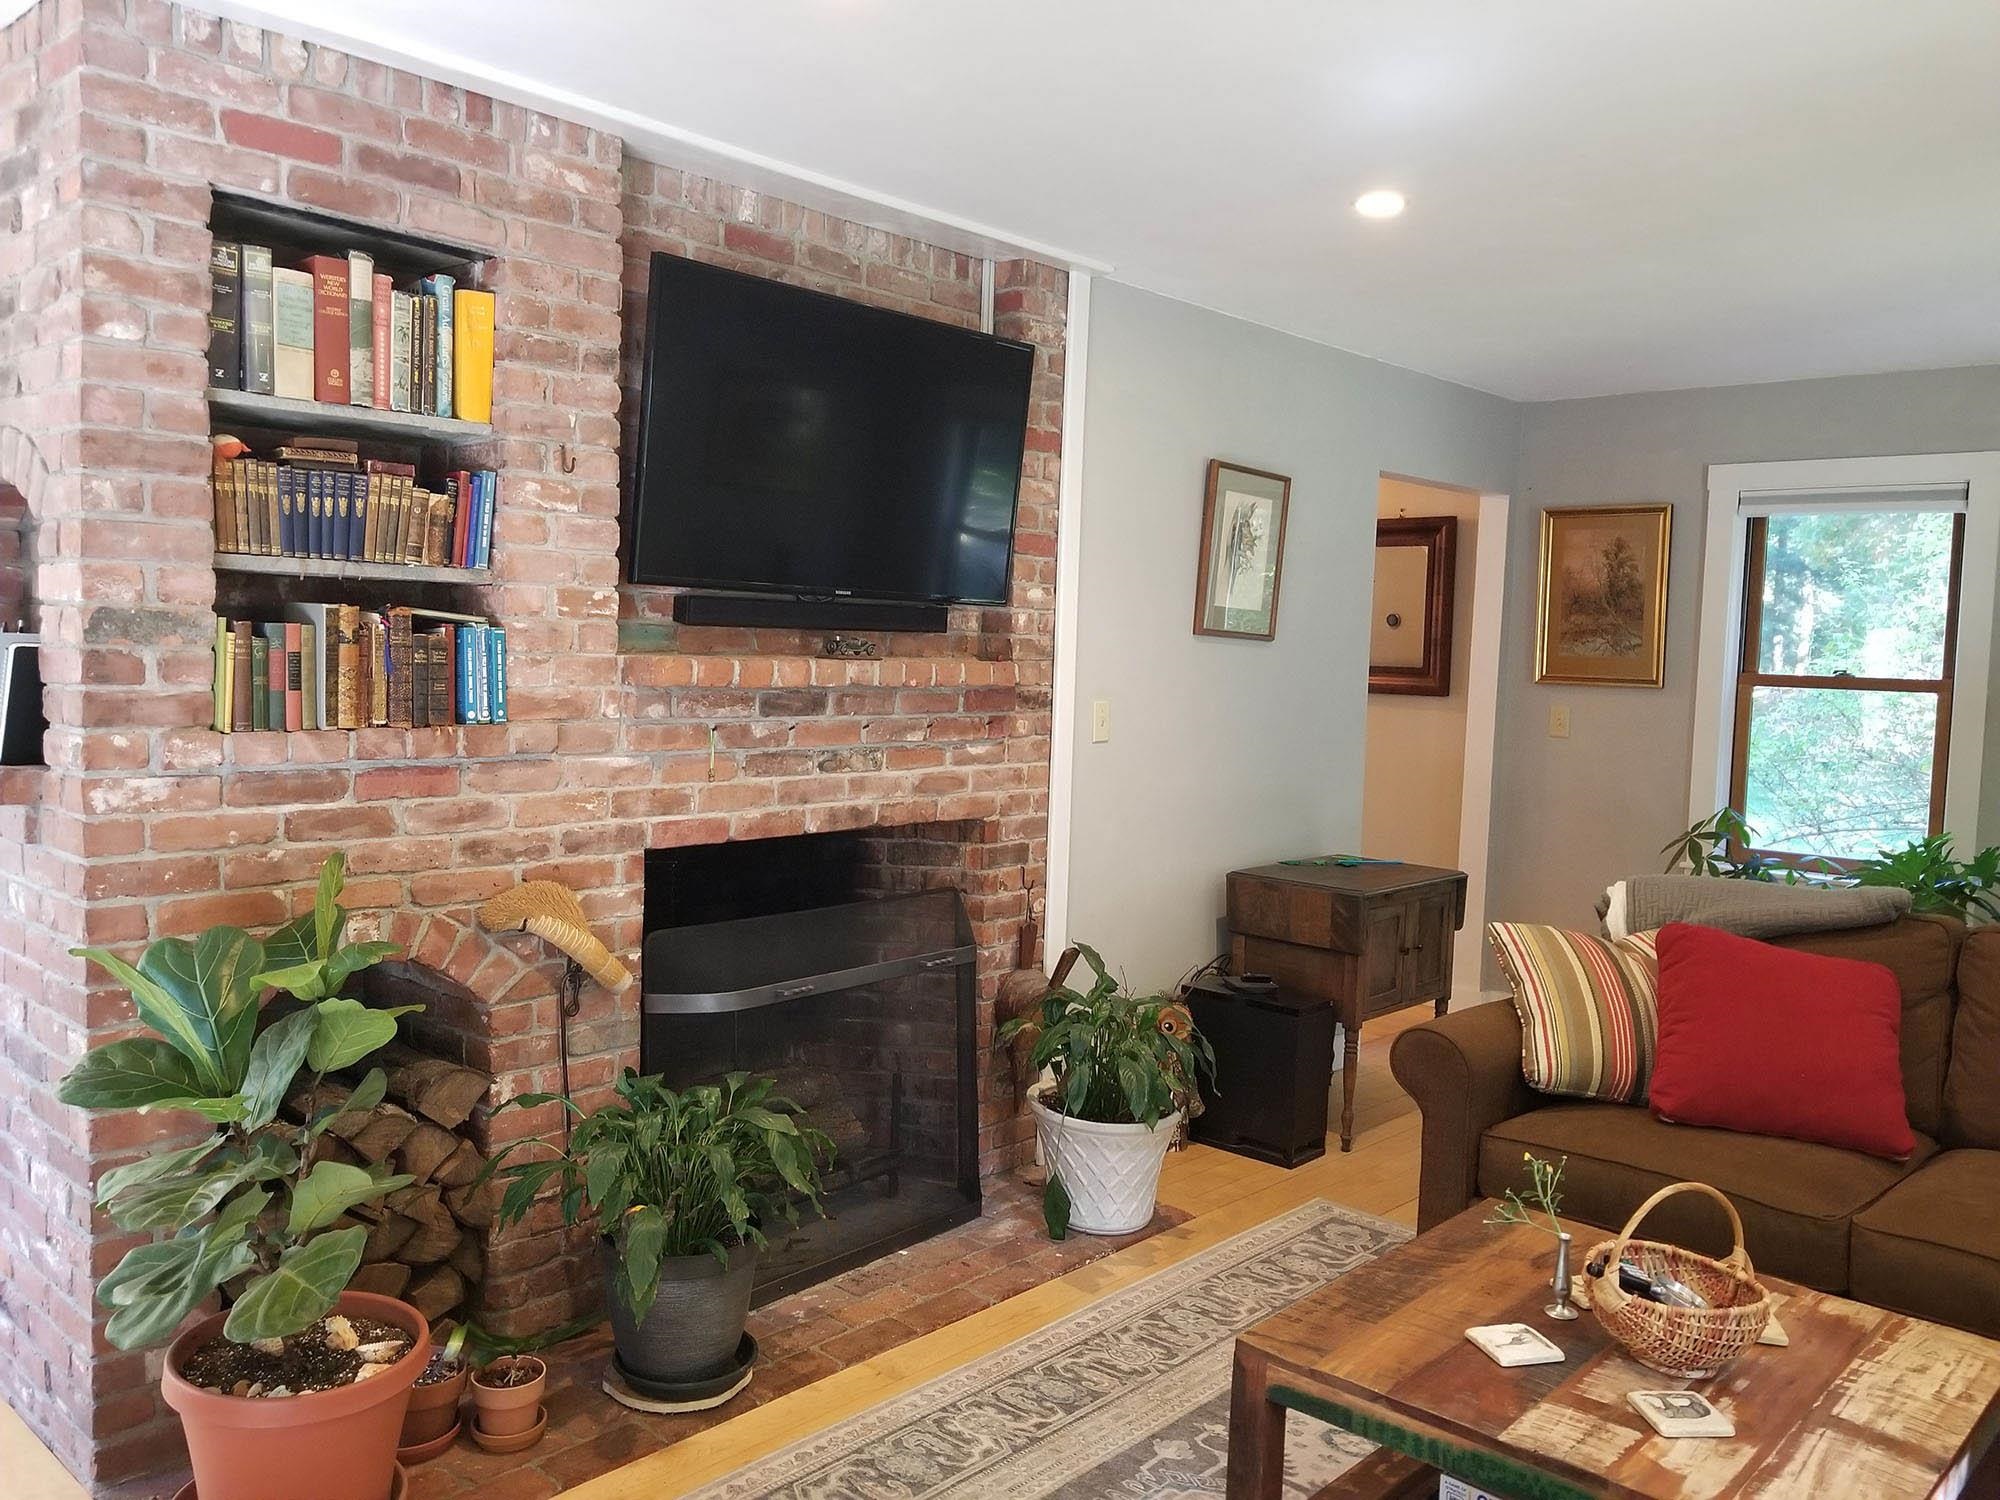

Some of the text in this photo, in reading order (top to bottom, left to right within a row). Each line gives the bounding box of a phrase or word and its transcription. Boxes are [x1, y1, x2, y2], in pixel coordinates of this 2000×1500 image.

[318, 288, 348, 298] DICTIONARY
[323, 284, 344, 292] WORLD
[442, 285, 451, 311] Great
